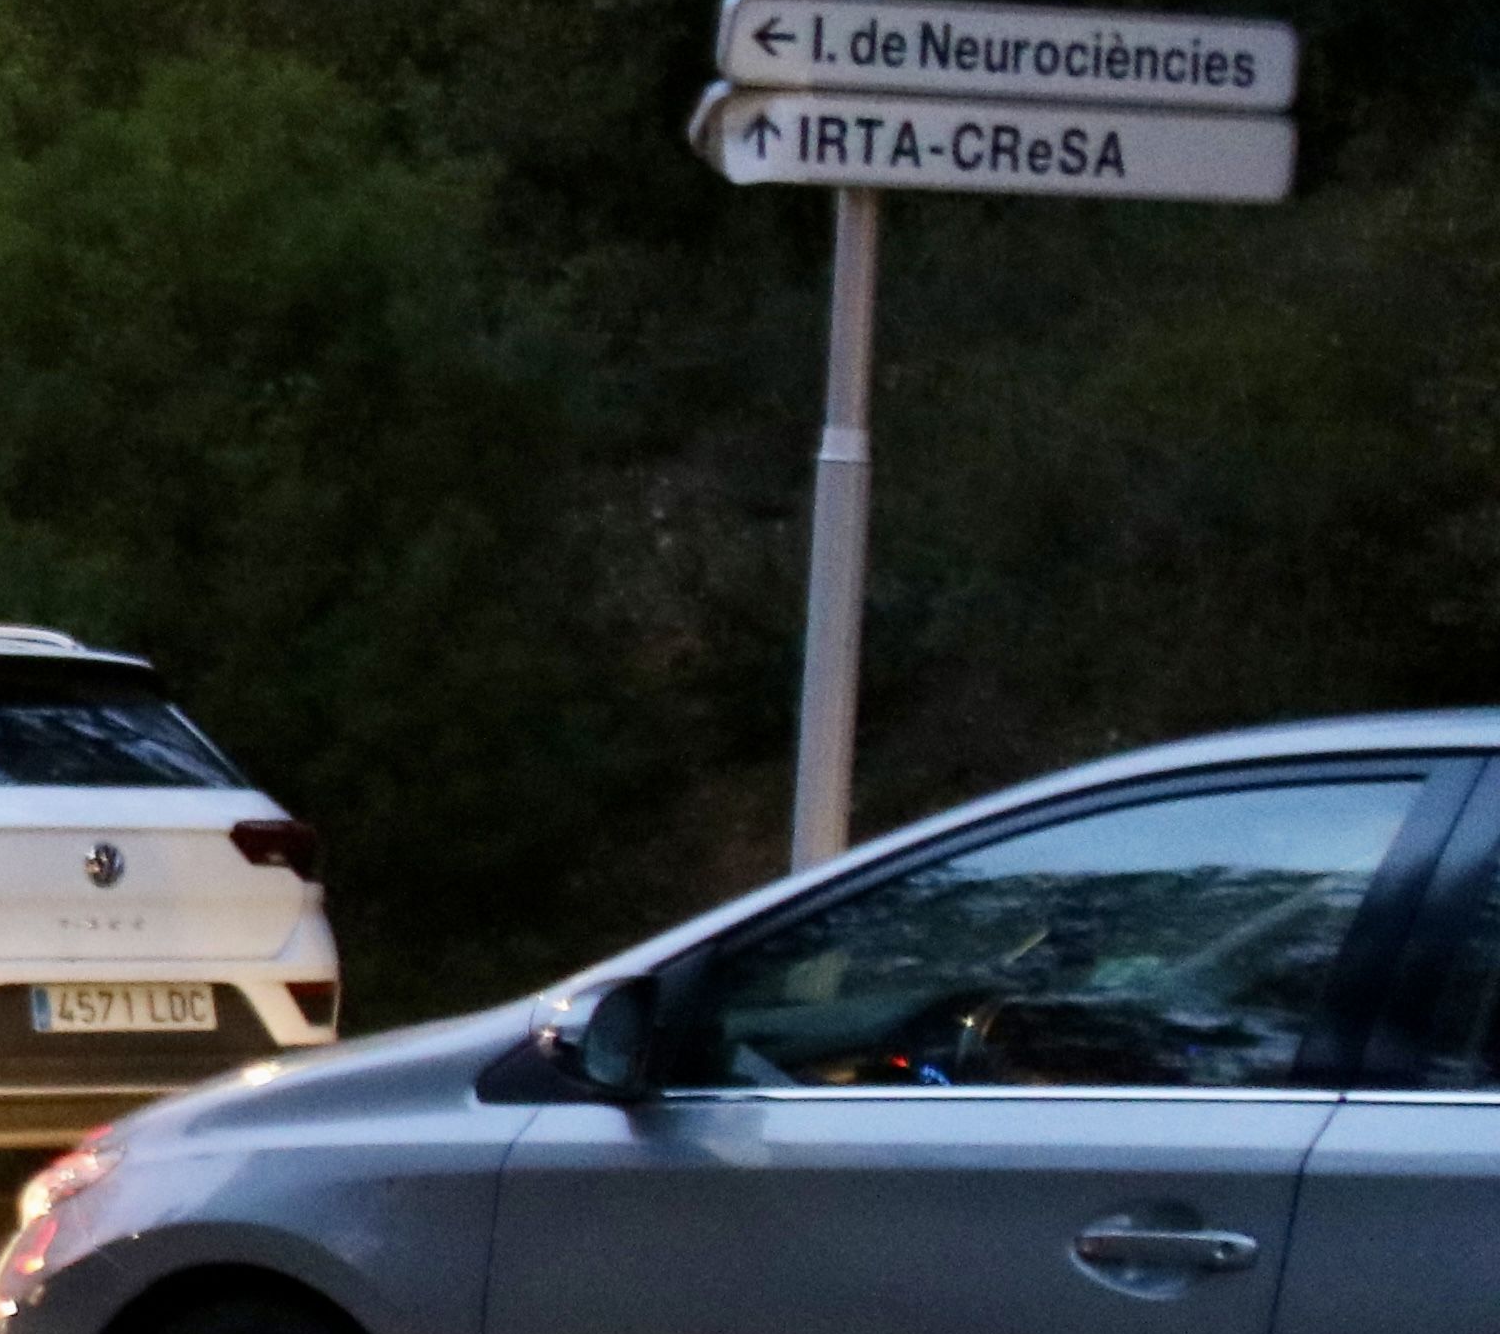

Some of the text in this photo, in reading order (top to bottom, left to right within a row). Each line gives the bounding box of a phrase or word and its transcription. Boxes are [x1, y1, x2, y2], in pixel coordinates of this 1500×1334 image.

[812, 15, 1257, 88] I. de Neurociències
[799, 114, 1127, 179] IRTA-CReSA
[58, 987, 207, 1023] 4571 LDC
